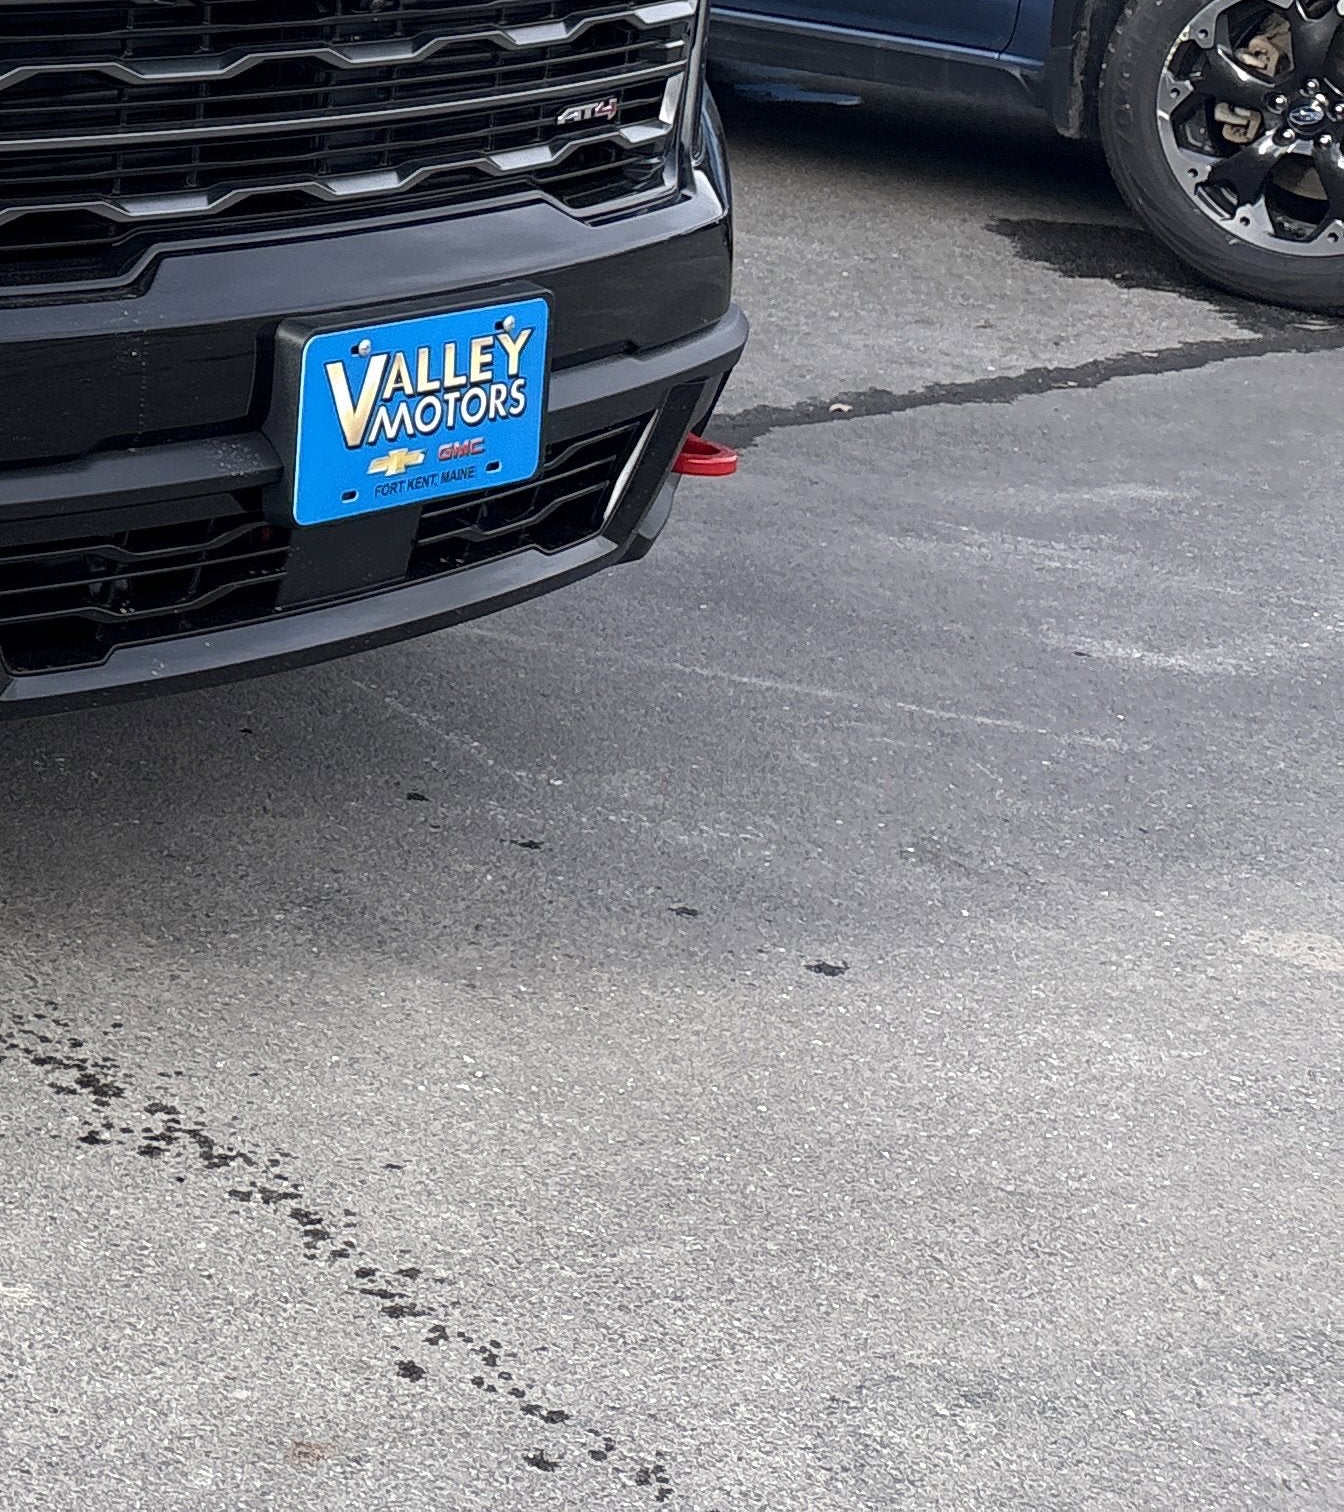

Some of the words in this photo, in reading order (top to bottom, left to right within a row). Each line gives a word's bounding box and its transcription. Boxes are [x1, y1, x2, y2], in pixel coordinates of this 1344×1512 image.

[556, 97, 619, 126] AT4
[324, 327, 534, 449] VALLEY
[367, 377, 527, 445] MOTORS
[437, 436, 486, 462] GMC
[374, 479, 405, 498] FORT
[440, 465, 477, 483] MAINE
